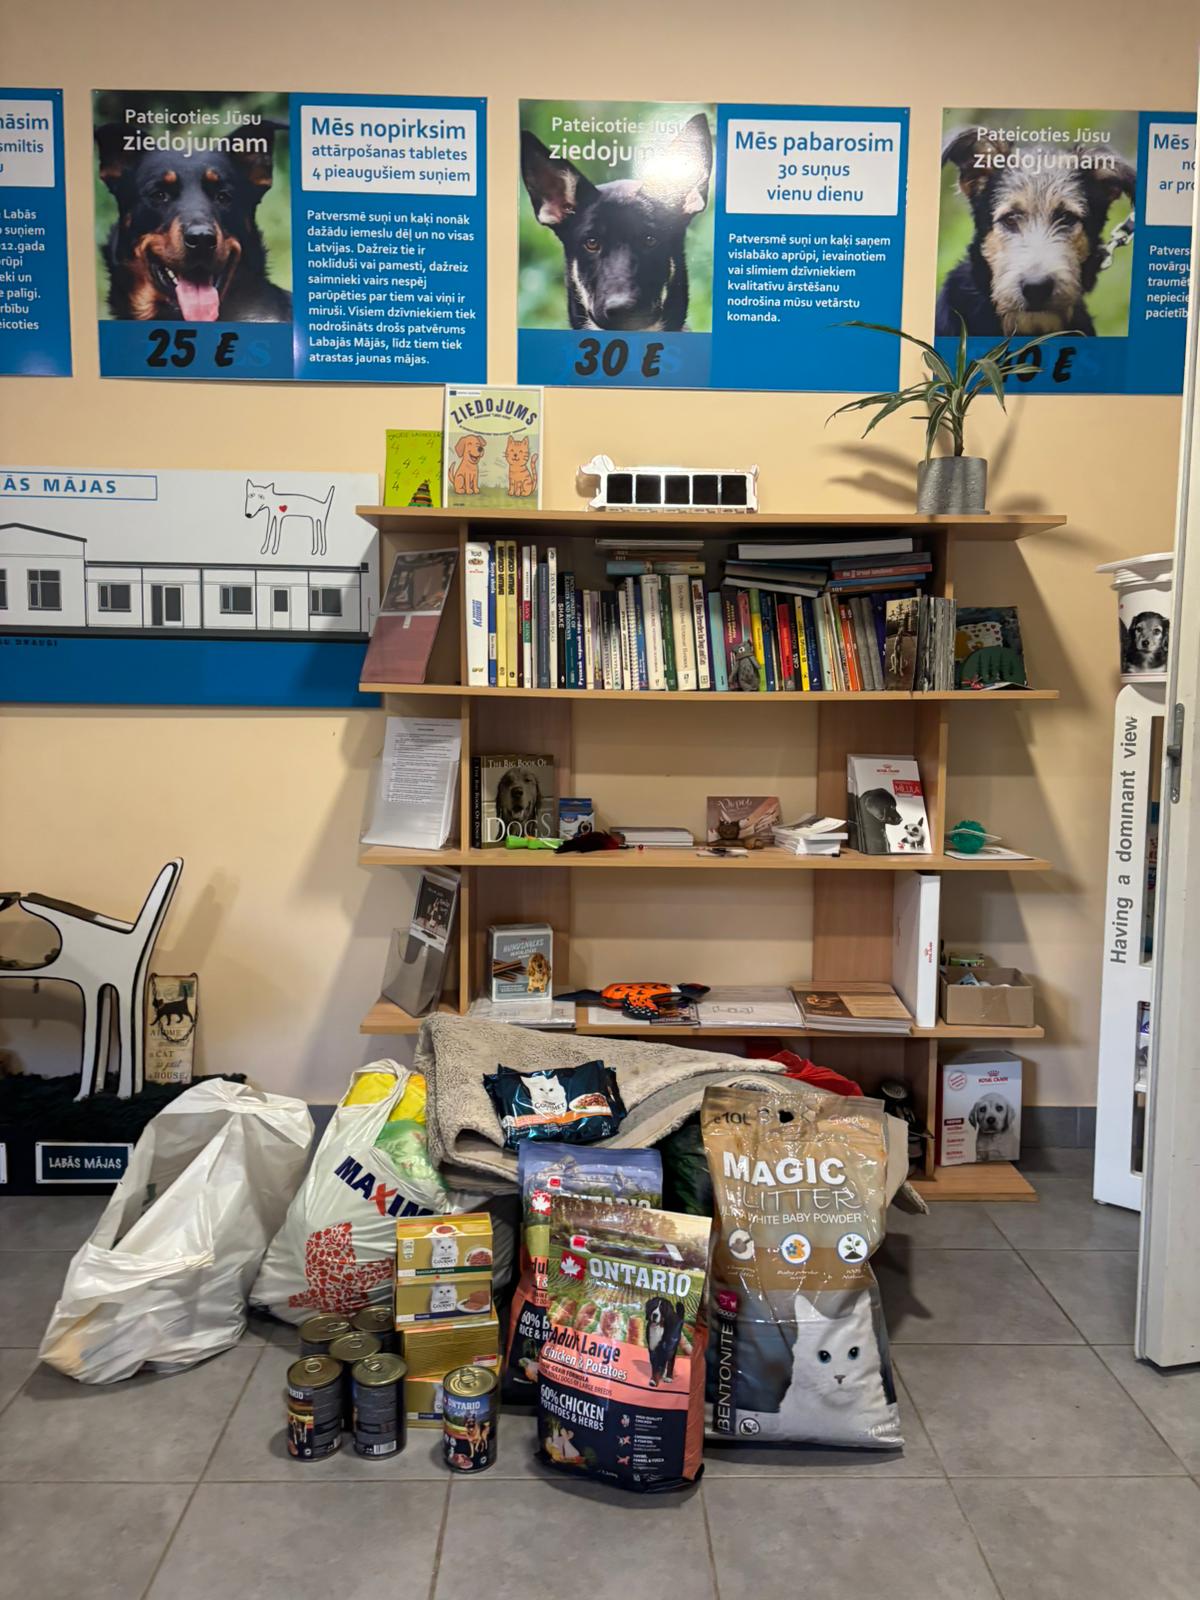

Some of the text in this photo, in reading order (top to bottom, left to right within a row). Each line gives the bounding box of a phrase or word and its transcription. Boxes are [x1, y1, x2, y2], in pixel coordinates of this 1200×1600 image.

[125, 109, 262, 126] Pateicoties Jūsu
[551, 116, 645, 134] Pateicoties
[311, 117, 466, 144] Mēs nopirksim
[976, 126, 1111, 143] Pateicoties Jūsu
[122, 129, 268, 157] ziedojumam
[735, 130, 894, 157] Mēs pabarosim
[1153, 133, 1190, 151] Mēs
[311, 144, 467, 161] attārpošanas tabletes
[973, 149, 1116, 175] ziedojumam
[312, 166, 471, 185] 4 pieaugušiem suņiem
[778, 164, 851, 184] 30 suņus
[767, 185, 865, 202] vienu dienu
[1159, 181, 1175, 191] ar
[4, 209, 37, 219] Labās
[308, 210, 366, 221] Patversmē
[369, 212, 391, 225] suņi
[411, 213, 433, 227] kaķi
[435, 214, 470, 224] nonāk
[5, 224, 45, 237] suņiem
[307, 226, 348, 236] dažādu
[350, 228, 393, 237] iemeslu
[396, 229, 412, 241] dēļ
[432, 232, 445, 240] no
[447, 230, 474, 241] visas
[308, 244, 425, 255] Latvijas. Dažreiz tie ir
[728, 233, 891, 249] Patversmē suņi un kaķi saņem
[728, 249, 886, 263] vislabāko aprūpi, ievainotiem
[308, 259, 468, 273] noklīduši vai pamesti, dažreiz
[728, 265, 856, 277] vai slimiem dzīvniekiem
[308, 274, 427, 289] saimnieki vairs nespēj
[727, 280, 840, 292] kvalitatīvu ārstēšanu
[7, 288, 41, 302] palīgi.
[309, 290, 466, 305] parūpēties par tiem vai viņi ir
[727, 296, 860, 308] nodrošina mūsu vetārstu
[309, 306, 476, 319] miruši. Visiem dzīvniekiem tiek
[727, 311, 781, 322] komanda.
[309, 321, 466, 335] nodrošināts drošs patvērums
[146, 329, 197, 367] 25
[309, 337, 462, 350] Labajās Mājās, līdz tiem tiek
[309, 353, 430, 366] atrastas jaunas mājas.
[575, 338, 629, 376] 30
[450, 398, 537, 426] ZIEDOJUMS
[3, 474, 117, 493] ĀS MĀJAS
[518, 758, 536, 768] BOOK
[486, 813, 552, 843] DOGS
[1110, 714, 1138, 964] Having a dominant view
[534, 1101, 566, 1112] GOURMET
[49, 1155, 122, 1170] LABĀS MĀJAS
[722, 1150, 847, 1187] MAGIC
[742, 1186, 863, 1211] LITTER
[782, 1211, 811, 1225] BABY
[813, 1212, 863, 1225] POWDER
[433, 1257, 457, 1266] GOURMET
[588, 1257, 692, 1297] ONTARIO
[432, 1302, 455, 1310] GOURMET
[520, 1310, 541, 1328] 60%
[519, 1325, 541, 1339] RICE &
[549, 1326, 621, 1365] Adult Large
[543, 1346, 628, 1381] Chicken & Potatoes
[716, 1324, 734, 1432] BENTONITE
[579, 1380, 594, 1392] LARGE
[595, 1385, 613, 1397] BREEDS
[447, 1399, 481, 1410] ONTARIO
[540, 1383, 605, 1422] 60% CHICKEN
[540, 1397, 605, 1431] POTATOES & HERBS
